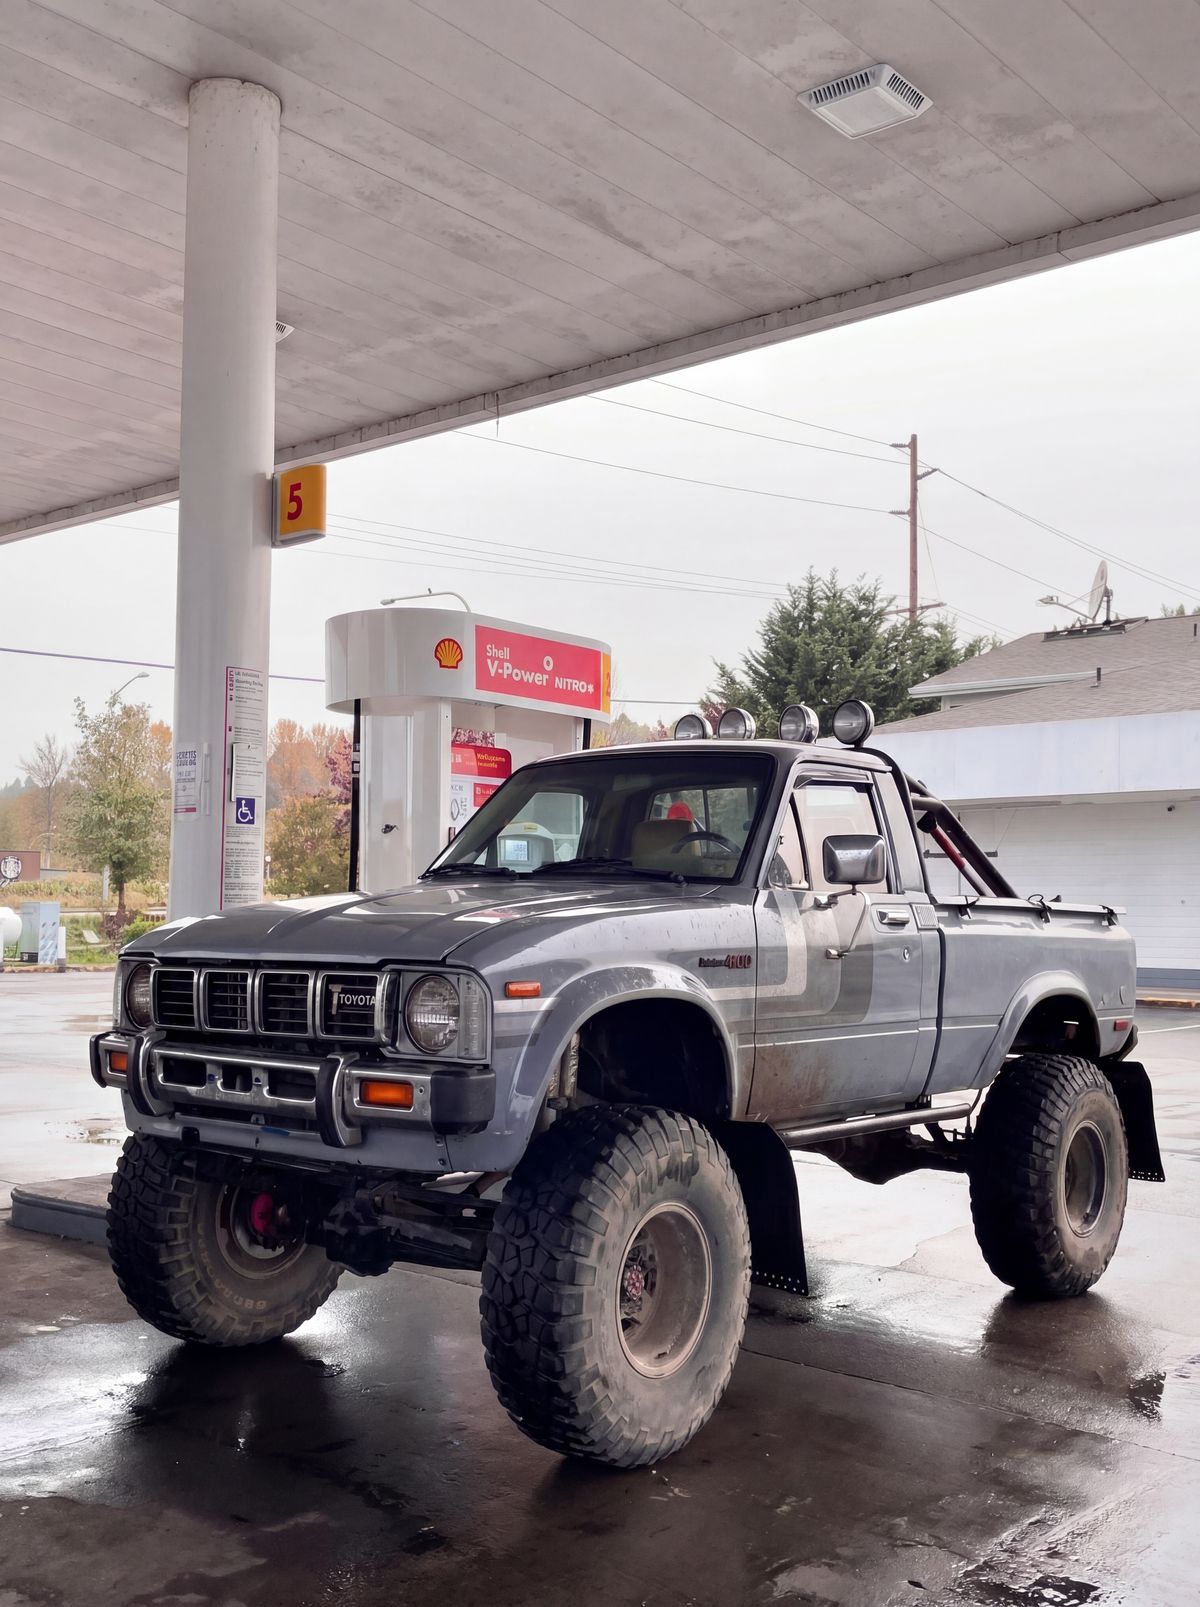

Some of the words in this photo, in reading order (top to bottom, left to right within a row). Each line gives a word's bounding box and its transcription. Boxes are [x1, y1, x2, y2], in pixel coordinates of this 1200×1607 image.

[287, 482, 303, 521] 5
[486, 644, 510, 660] Shell
[486, 659, 549, 686] V-Power
[339, 994, 376, 1006] TOYOTA
